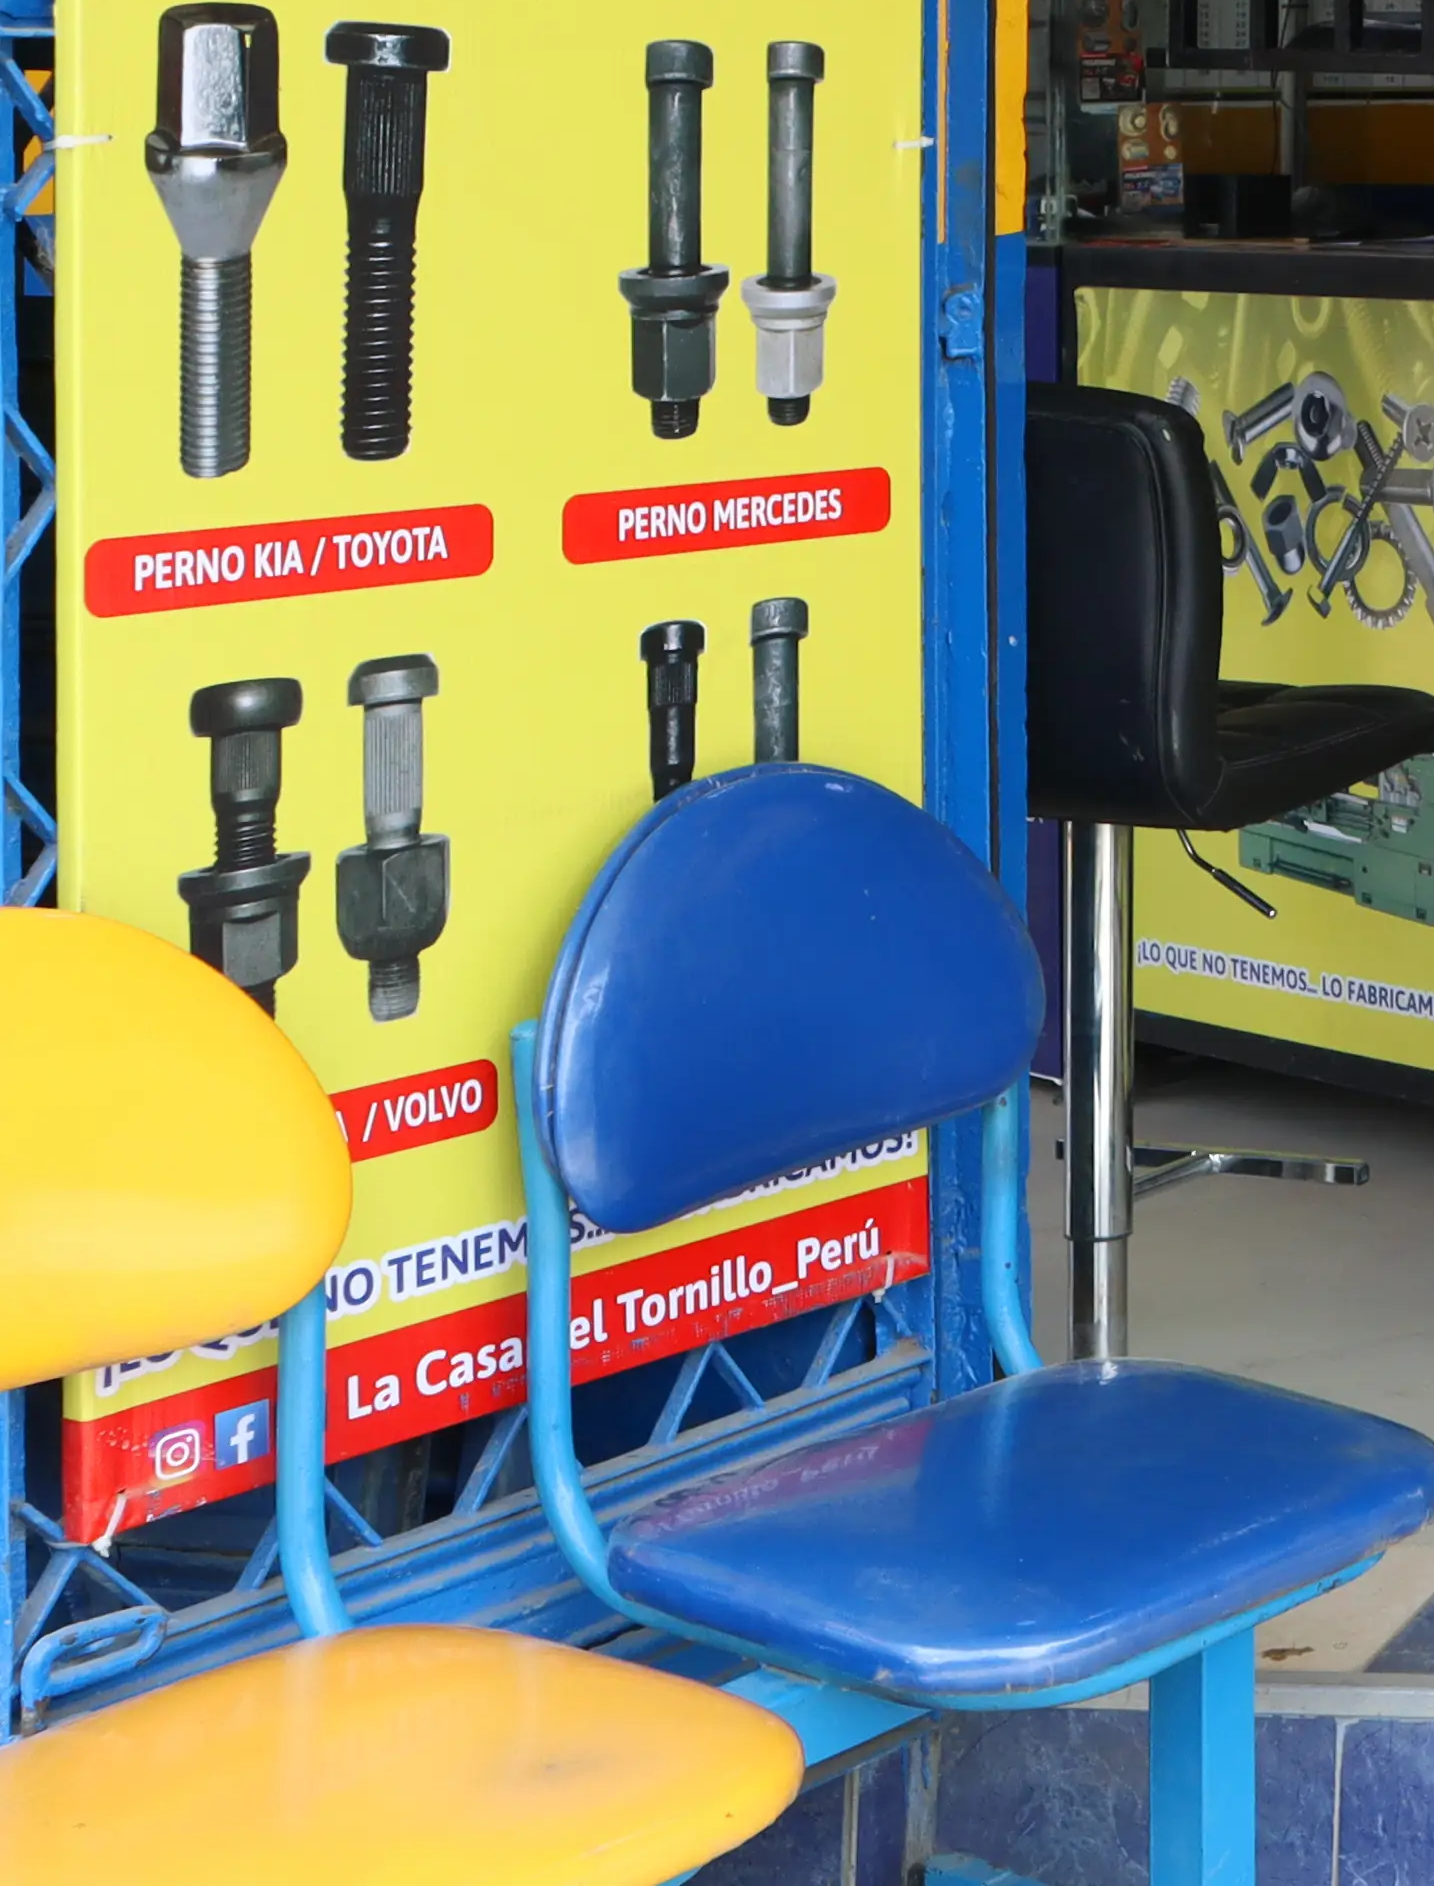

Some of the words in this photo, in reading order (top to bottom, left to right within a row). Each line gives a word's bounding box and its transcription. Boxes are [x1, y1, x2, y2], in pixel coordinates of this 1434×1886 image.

[620, 502, 705, 541] PERNO
[714, 489, 841, 530] MERCEDES
[135, 546, 244, 590] PERNO
[255, 540, 303, 578] KIA
[333, 526, 447, 569] TOYOTA
[1138, 941, 1161, 967] ¡LO
[1165, 946, 1197, 975] QUE
[1203, 953, 1226, 976] NO
[1322, 976, 1343, 996] LO
[384, 1080, 481, 1131] VOLVO
[347, 1374, 400, 1421] La
[415, 1336, 524, 1396] Casa
[616, 1218, 881, 1333] Tornillo_Perú
